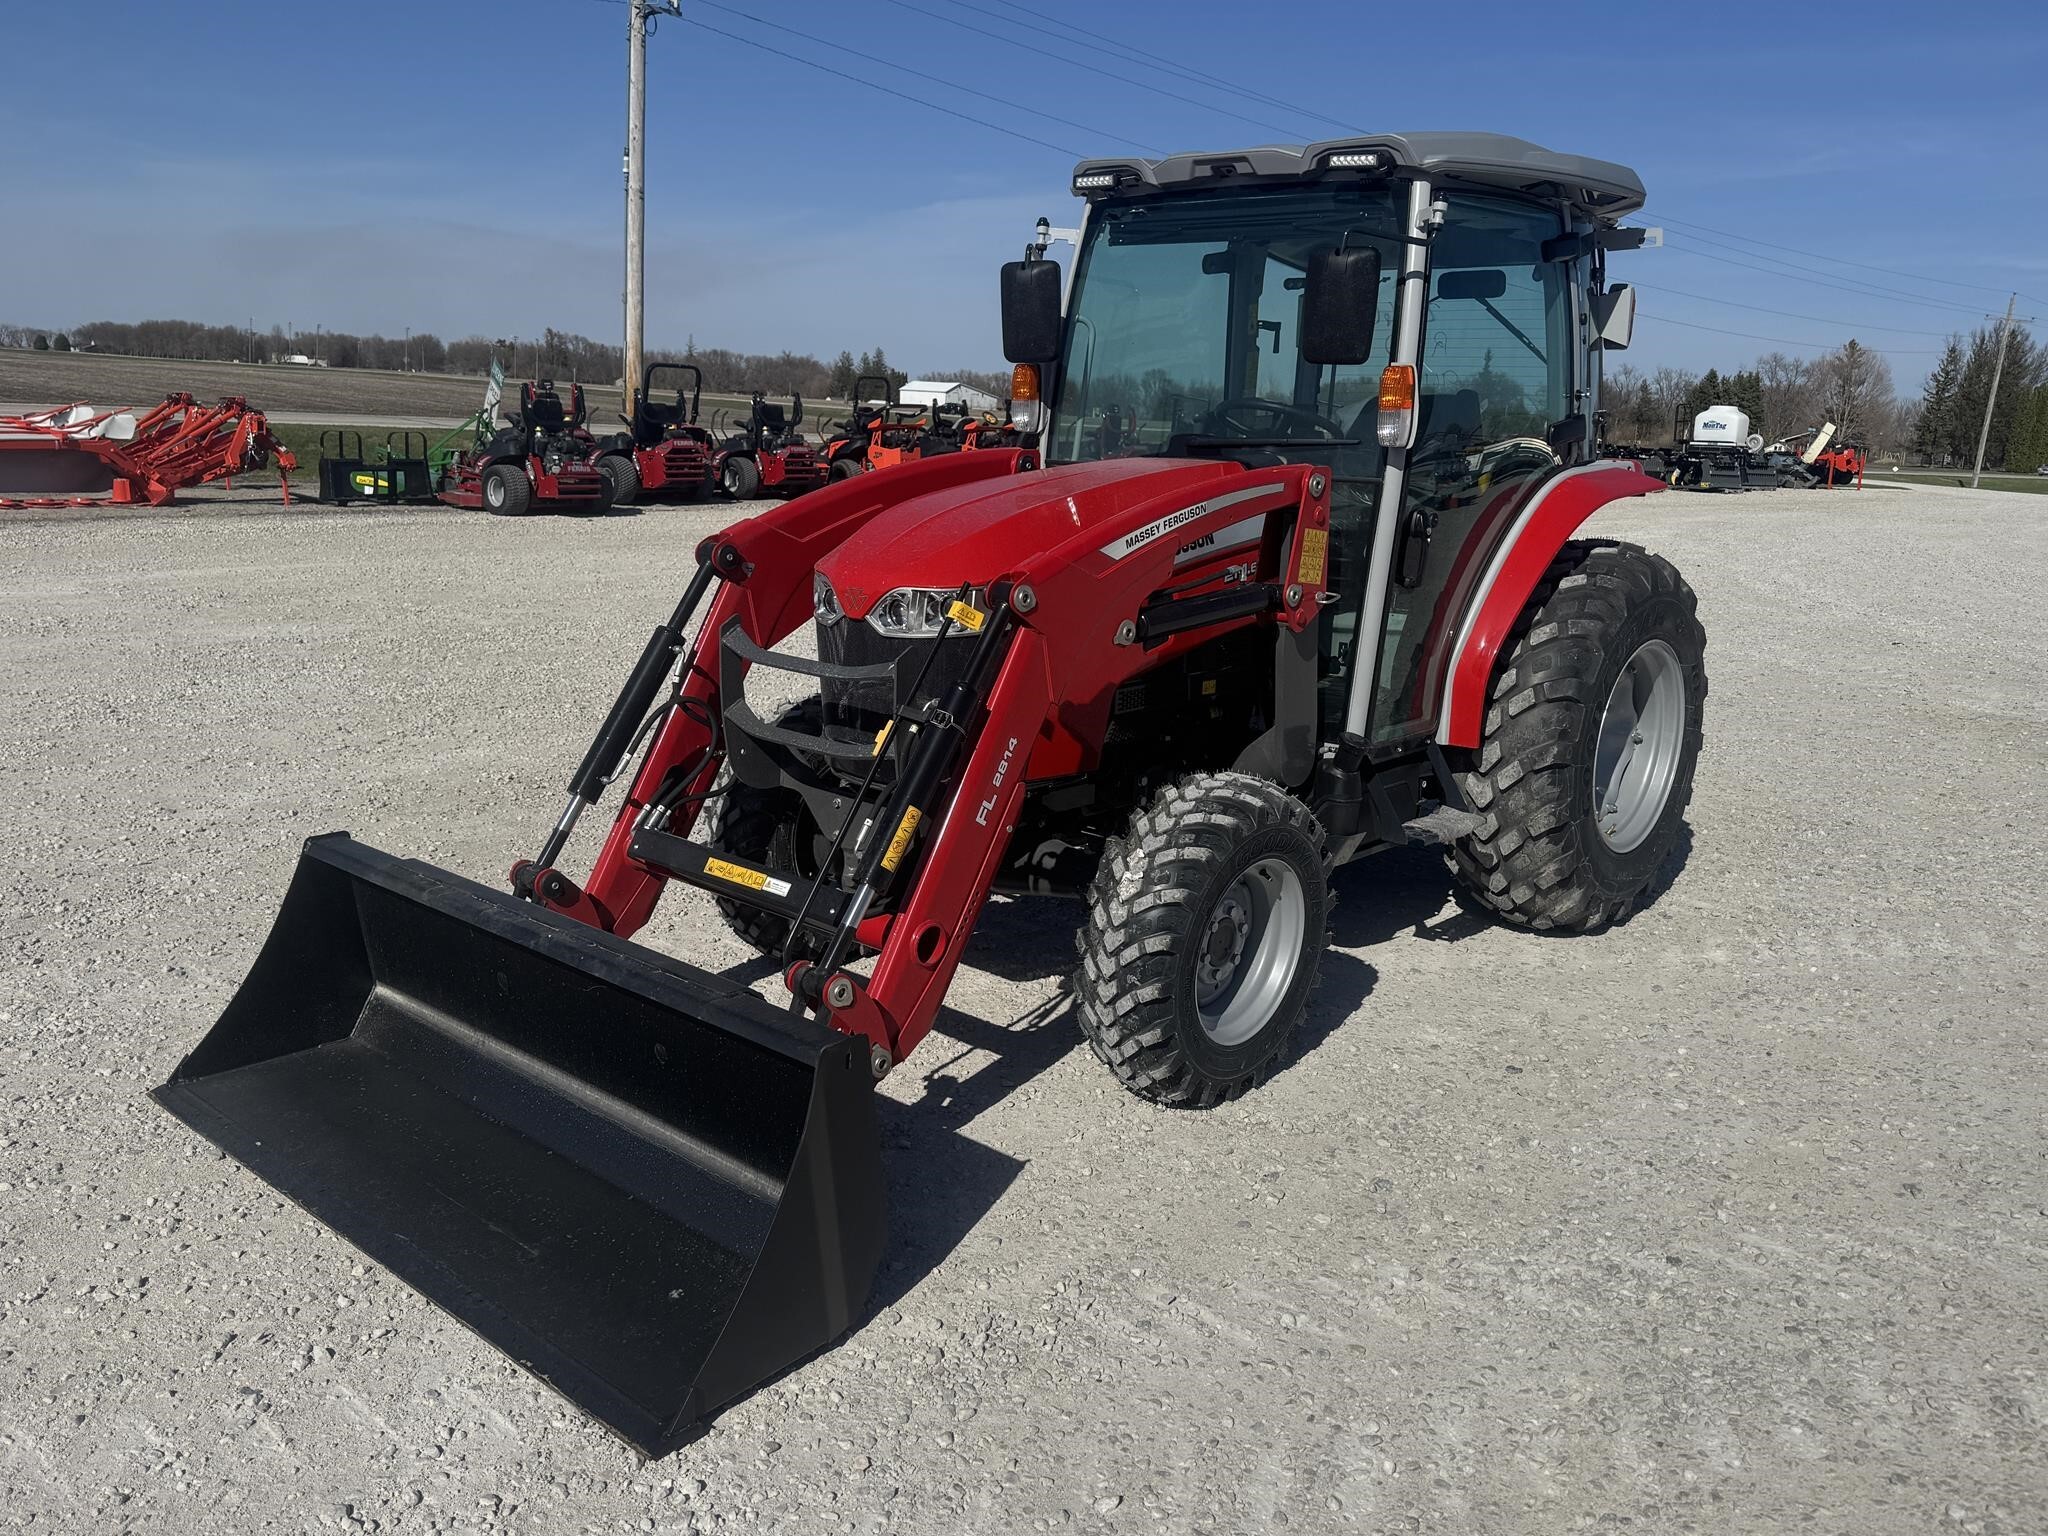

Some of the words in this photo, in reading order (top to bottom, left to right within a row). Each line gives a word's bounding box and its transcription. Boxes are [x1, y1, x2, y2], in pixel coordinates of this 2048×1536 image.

[1125, 523, 1161, 549] MASSEY
[1163, 503, 1207, 531] FERGUSON
[975, 794, 998, 826] FL
[992, 737, 1018, 788] 2814
